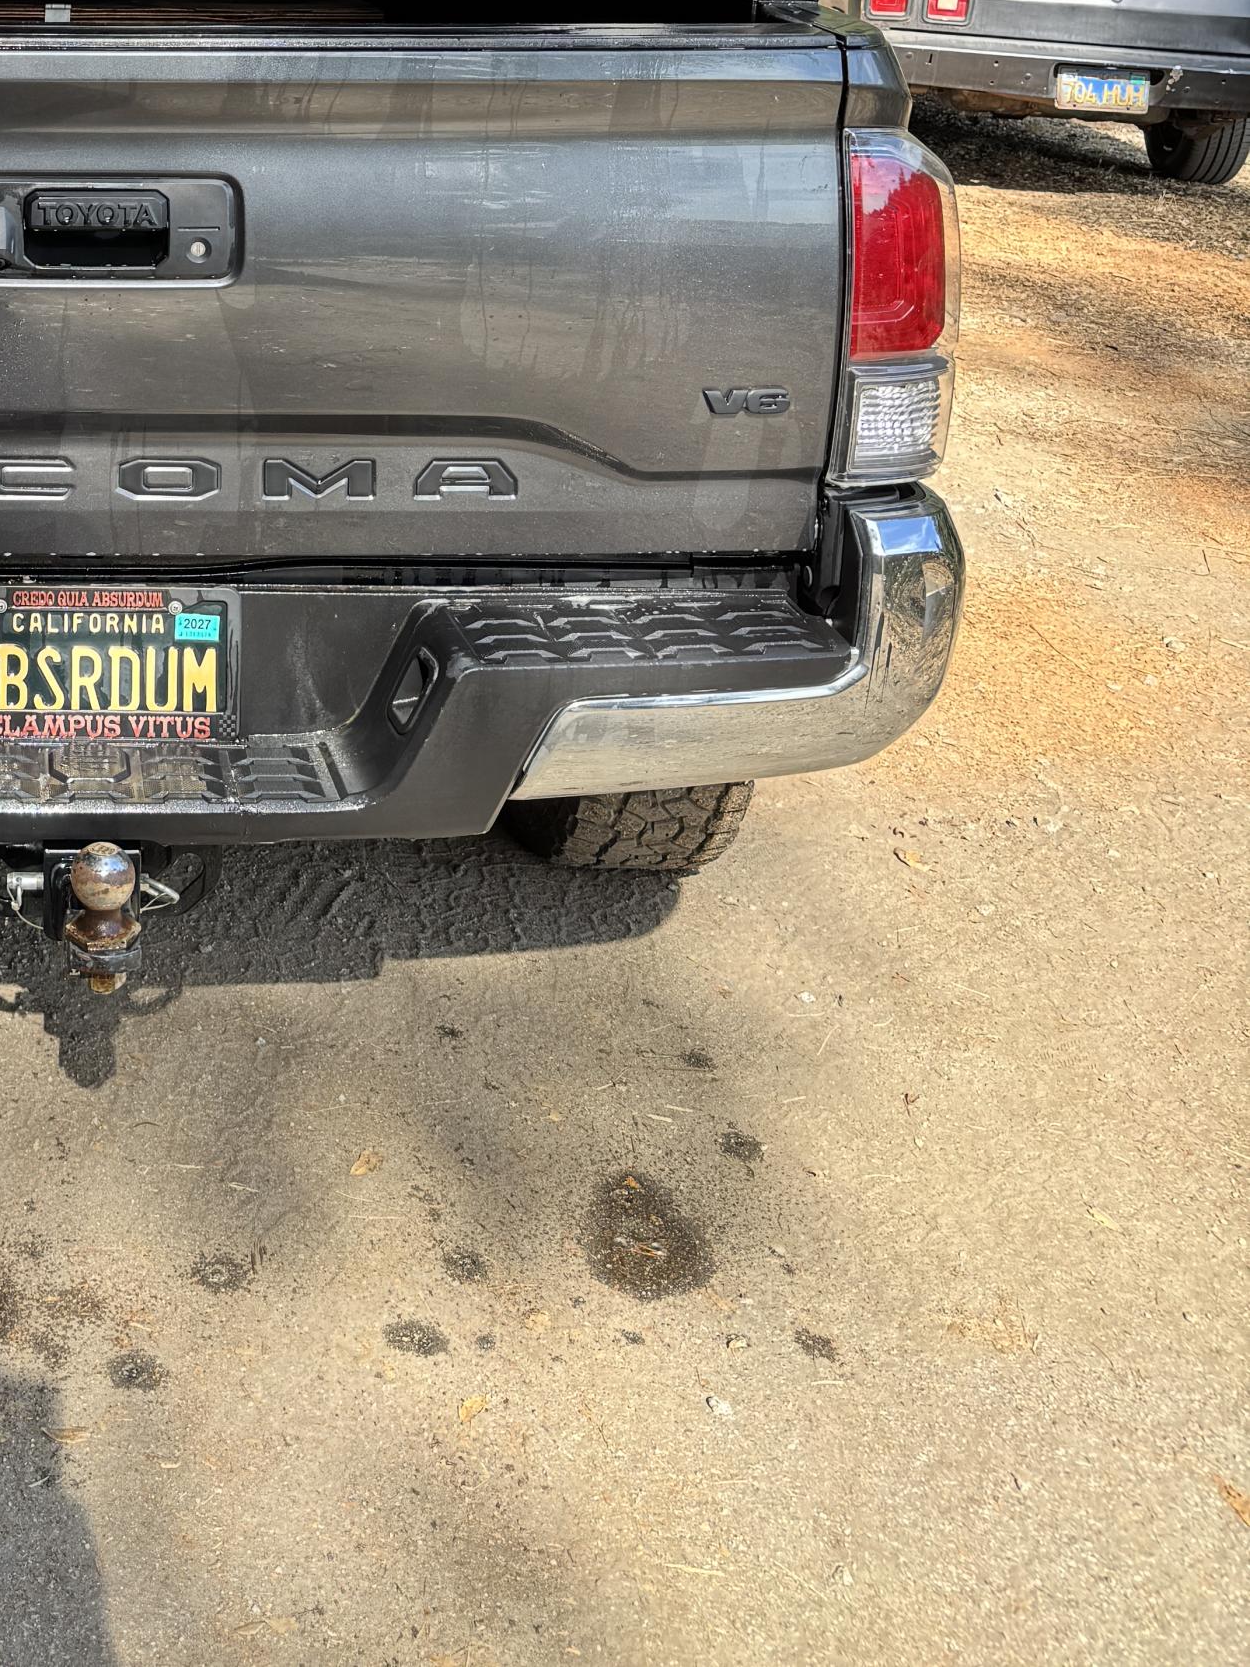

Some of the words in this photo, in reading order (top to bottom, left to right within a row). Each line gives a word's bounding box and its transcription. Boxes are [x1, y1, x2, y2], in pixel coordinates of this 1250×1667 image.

[37, 202, 158, 226] TOYOTA
[702, 386, 791, 415] V6
[12, 591, 55, 607] CREDO
[57, 592, 89, 607] QUIA
[92, 591, 164, 608] ABSURDUM
[12, 612, 165, 634] CALIFORNIA
[184, 618, 211, 630] 2027
[128, 715, 211, 739] VITUS
